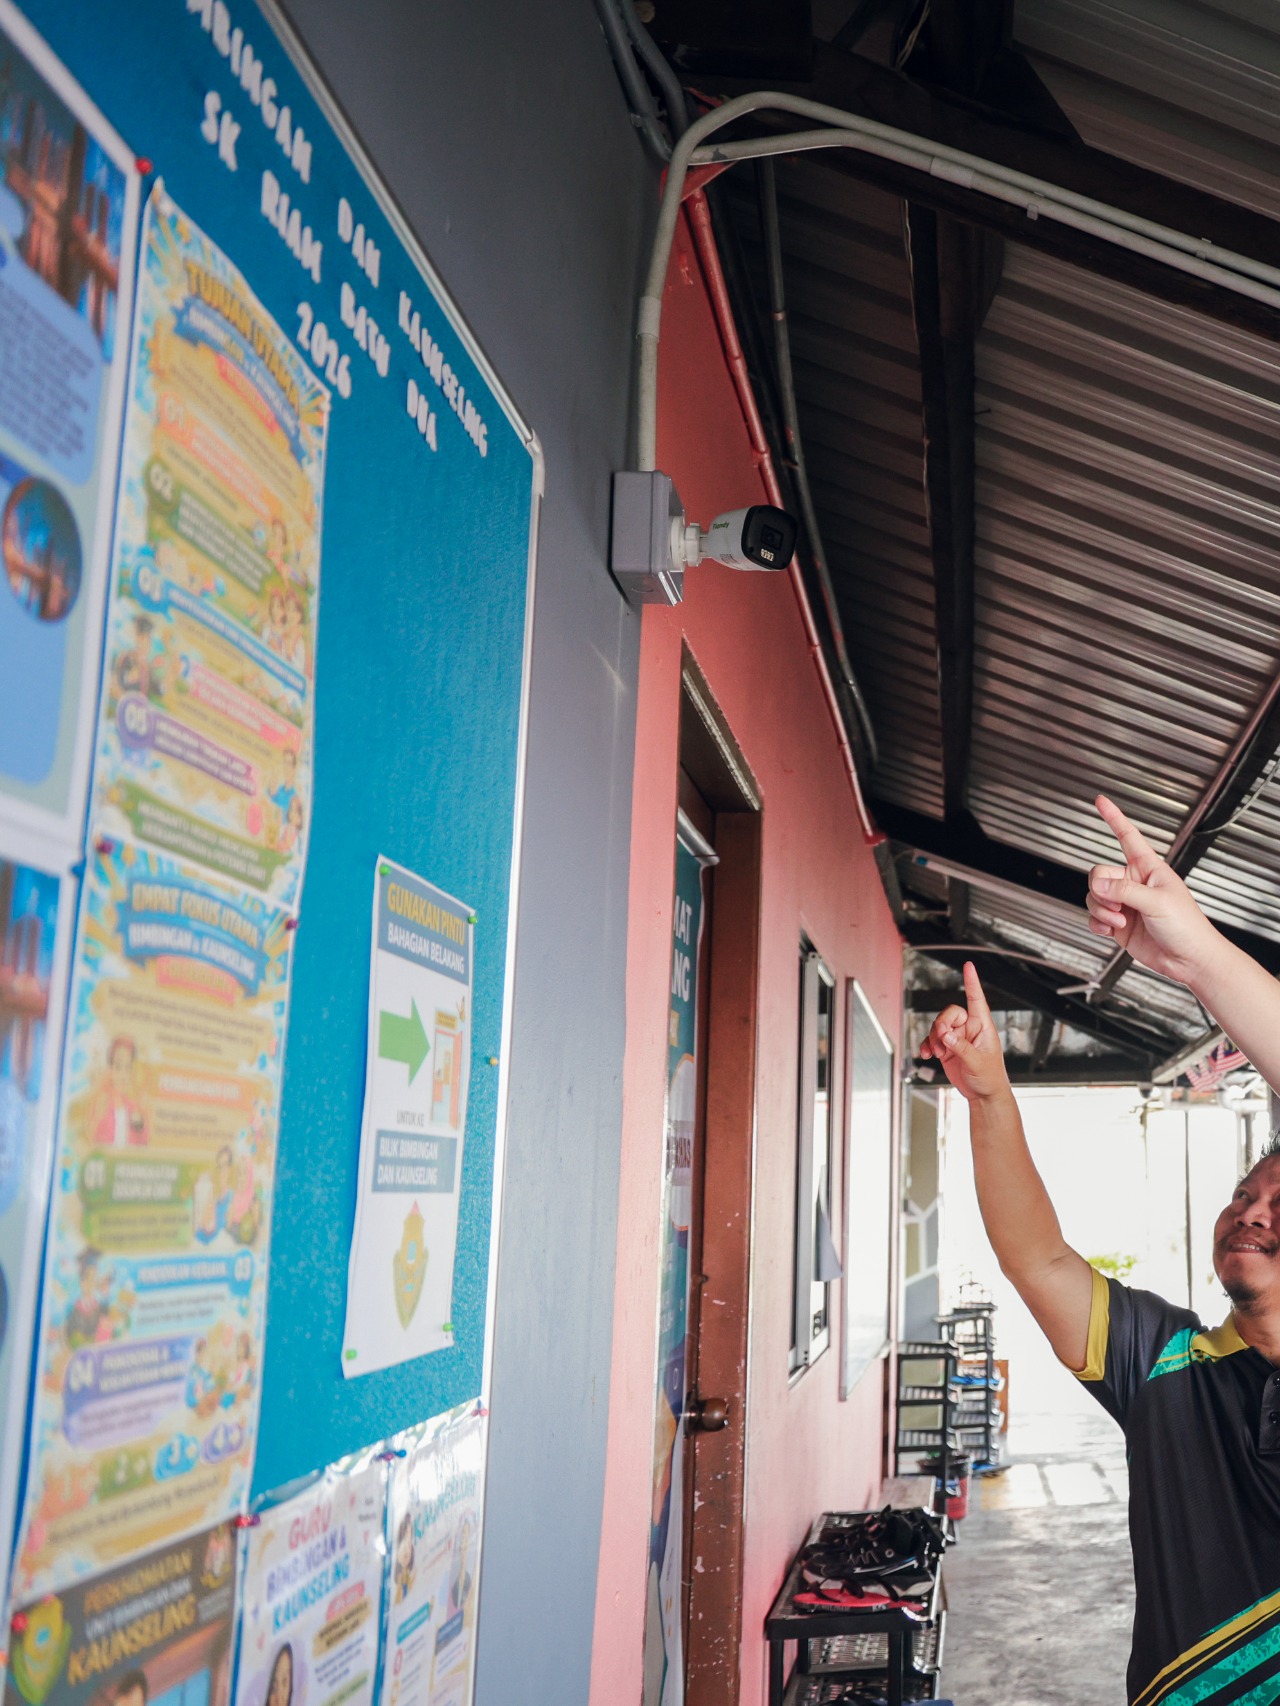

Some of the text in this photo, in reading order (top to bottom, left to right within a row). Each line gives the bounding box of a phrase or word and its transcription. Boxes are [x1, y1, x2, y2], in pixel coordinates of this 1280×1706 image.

[186, 0, 488, 458] BINGAN DAN KAUNSELING
[201, 90, 437, 452] SK RIAM BATU DUA
[296, 301, 352, 399] 2026
[132, 883, 180, 913] EMPAT
[387, 882, 466, 946] GUNAKAN PINTU
[387, 922, 465, 975] BAHAGIAN BELAKANG
[396, 1109, 425, 1128] UNTUK KE
[377, 1163, 438, 1186] DAN KAUNSELING
[379, 1136, 439, 1160] BILIK BIMBINGAN
[288, 1498, 332, 1551] GURU
[272, 1552, 350, 1635] KAUNSELING
